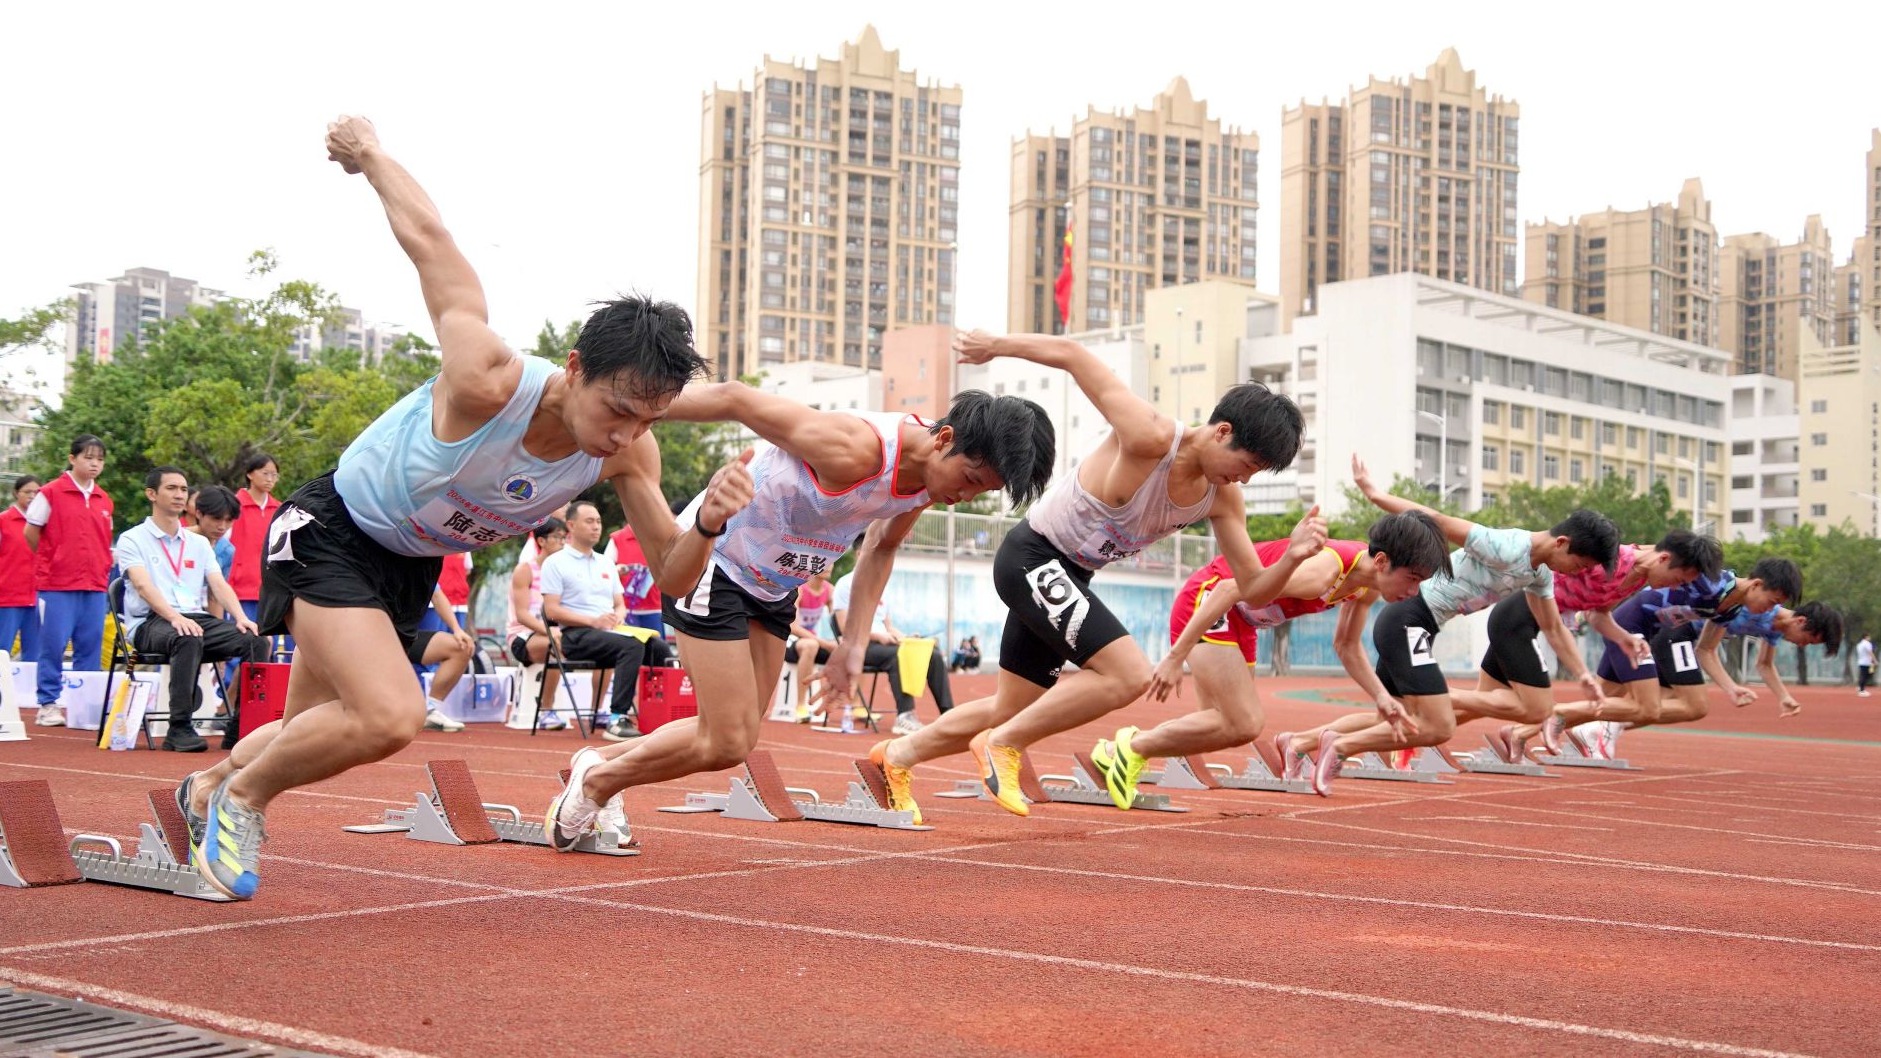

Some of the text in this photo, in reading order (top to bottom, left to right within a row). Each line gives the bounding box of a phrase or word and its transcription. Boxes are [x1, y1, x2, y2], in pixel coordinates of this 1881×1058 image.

[443, 510, 510, 542] 陆志
[1037, 568, 1073, 606] 6
[1413, 631, 1434, 660] 4
[480, 686, 487, 699] 3
[783, 671, 791, 705] 1
